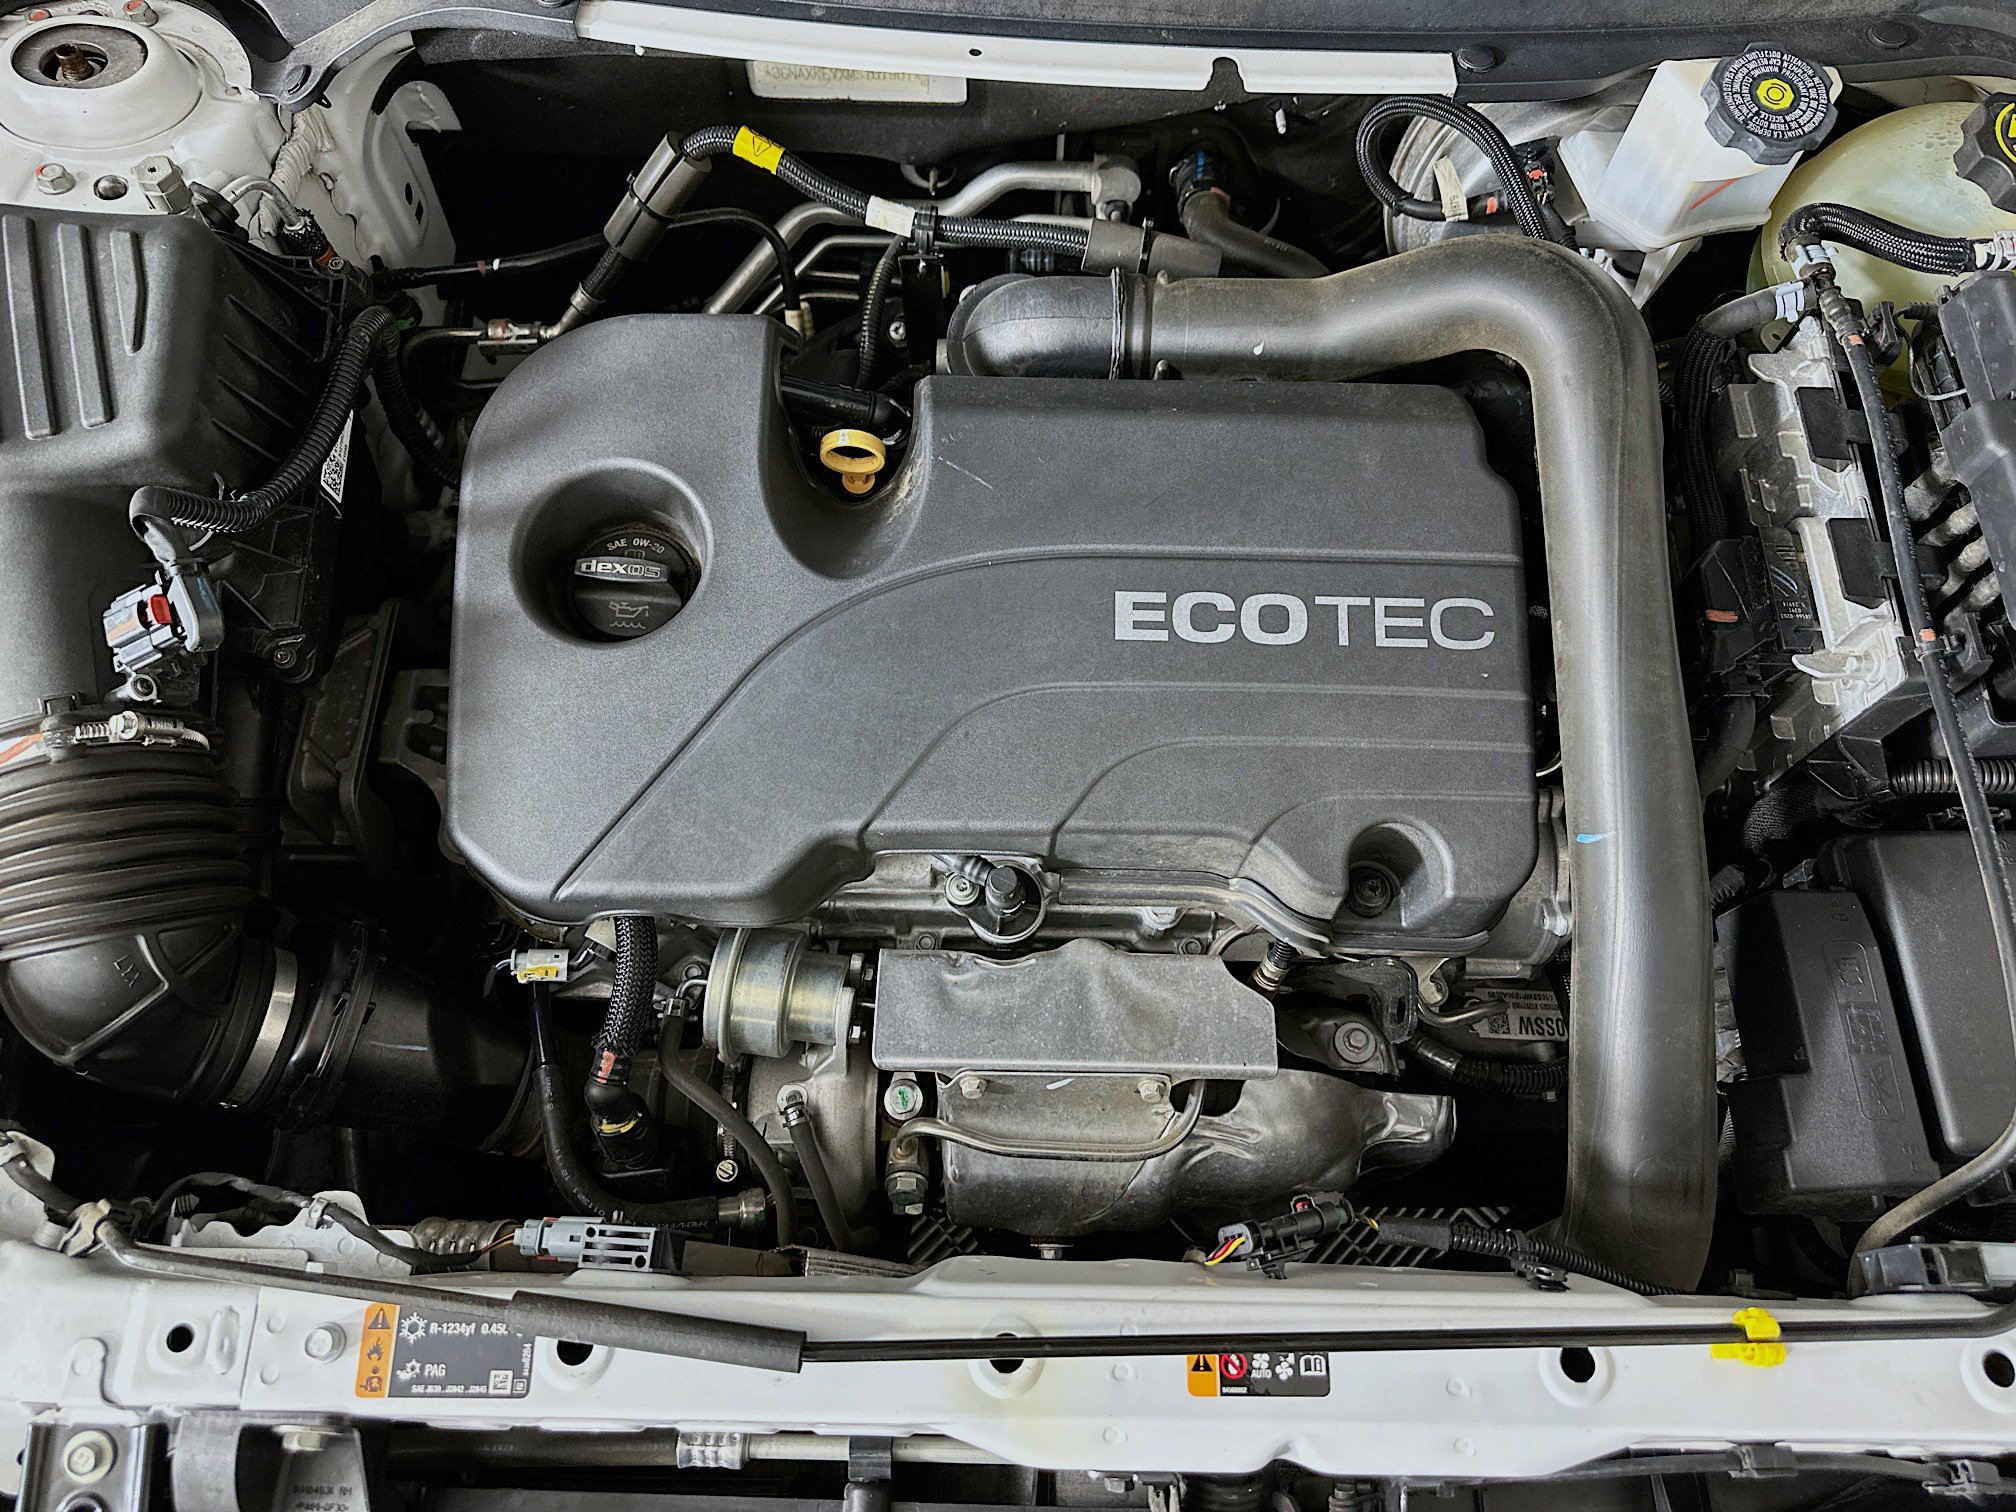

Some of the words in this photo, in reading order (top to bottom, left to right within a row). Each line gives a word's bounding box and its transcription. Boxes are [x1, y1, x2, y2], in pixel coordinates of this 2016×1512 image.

[1731, 55, 1748, 70] FROM
[1722, 70, 1734, 91] SEALED
[1733, 93, 1743, 105] USE
[1817, 104, 1826, 112] LE
[1769, 122, 1789, 130] FREIN
[1788, 120, 1799, 129] DE
[1801, 110, 1824, 133] BOUCHON
[1783, 127, 1804, 138] AVANT
[607, 538, 627, 551] SAE
[633, 538, 665, 554] 0W-20
[581, 560, 661, 578] dexos
[1114, 591, 1495, 650] ECOTEC
[429, 1322, 475, 1337] R-1234yf
[424, 1364, 446, 1377] PAG
[1251, 1369, 1272, 1379] AUTO
[411, 1384, 425, 1393] SAE
